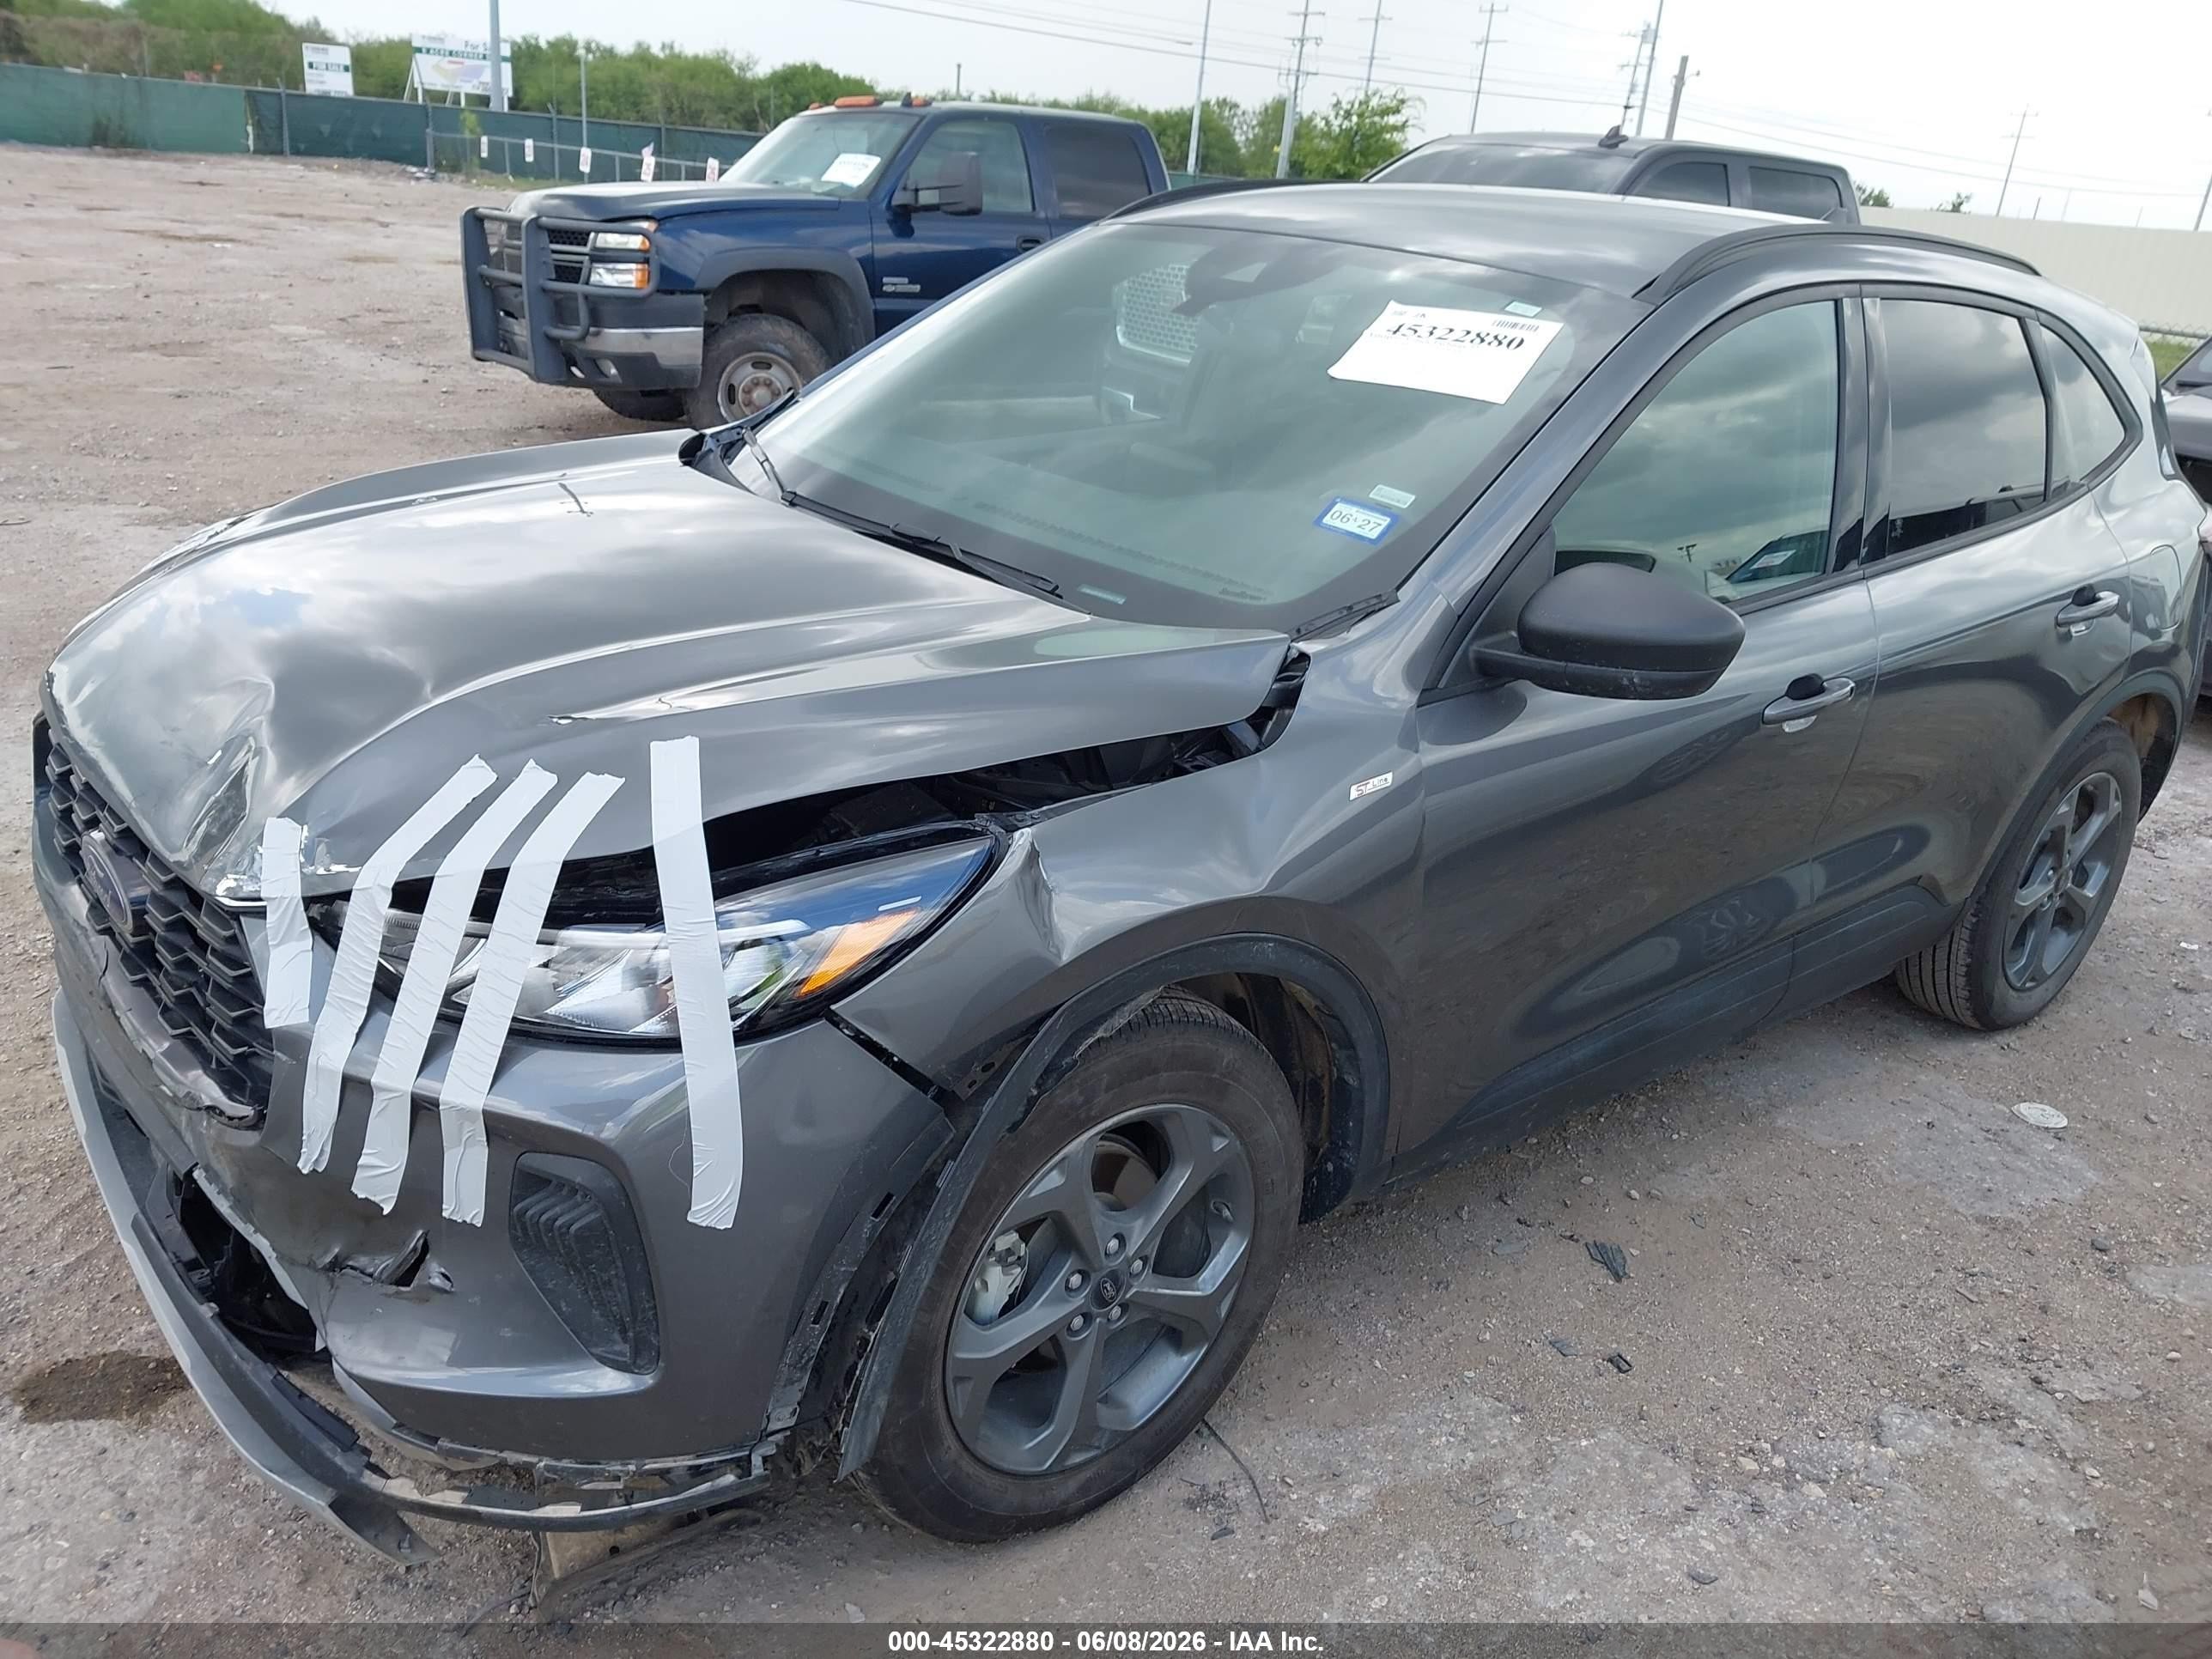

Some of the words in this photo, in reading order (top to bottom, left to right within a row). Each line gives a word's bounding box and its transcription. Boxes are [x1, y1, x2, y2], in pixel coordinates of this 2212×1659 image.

[464, 40, 479, 50] For
[1386, 321, 1525, 350] 45322880
[1329, 509, 1353, 525] 06
[1356, 519, 1382, 533] 27
[1355, 781, 1371, 797] ST
[1372, 776, 1389, 787] Line
